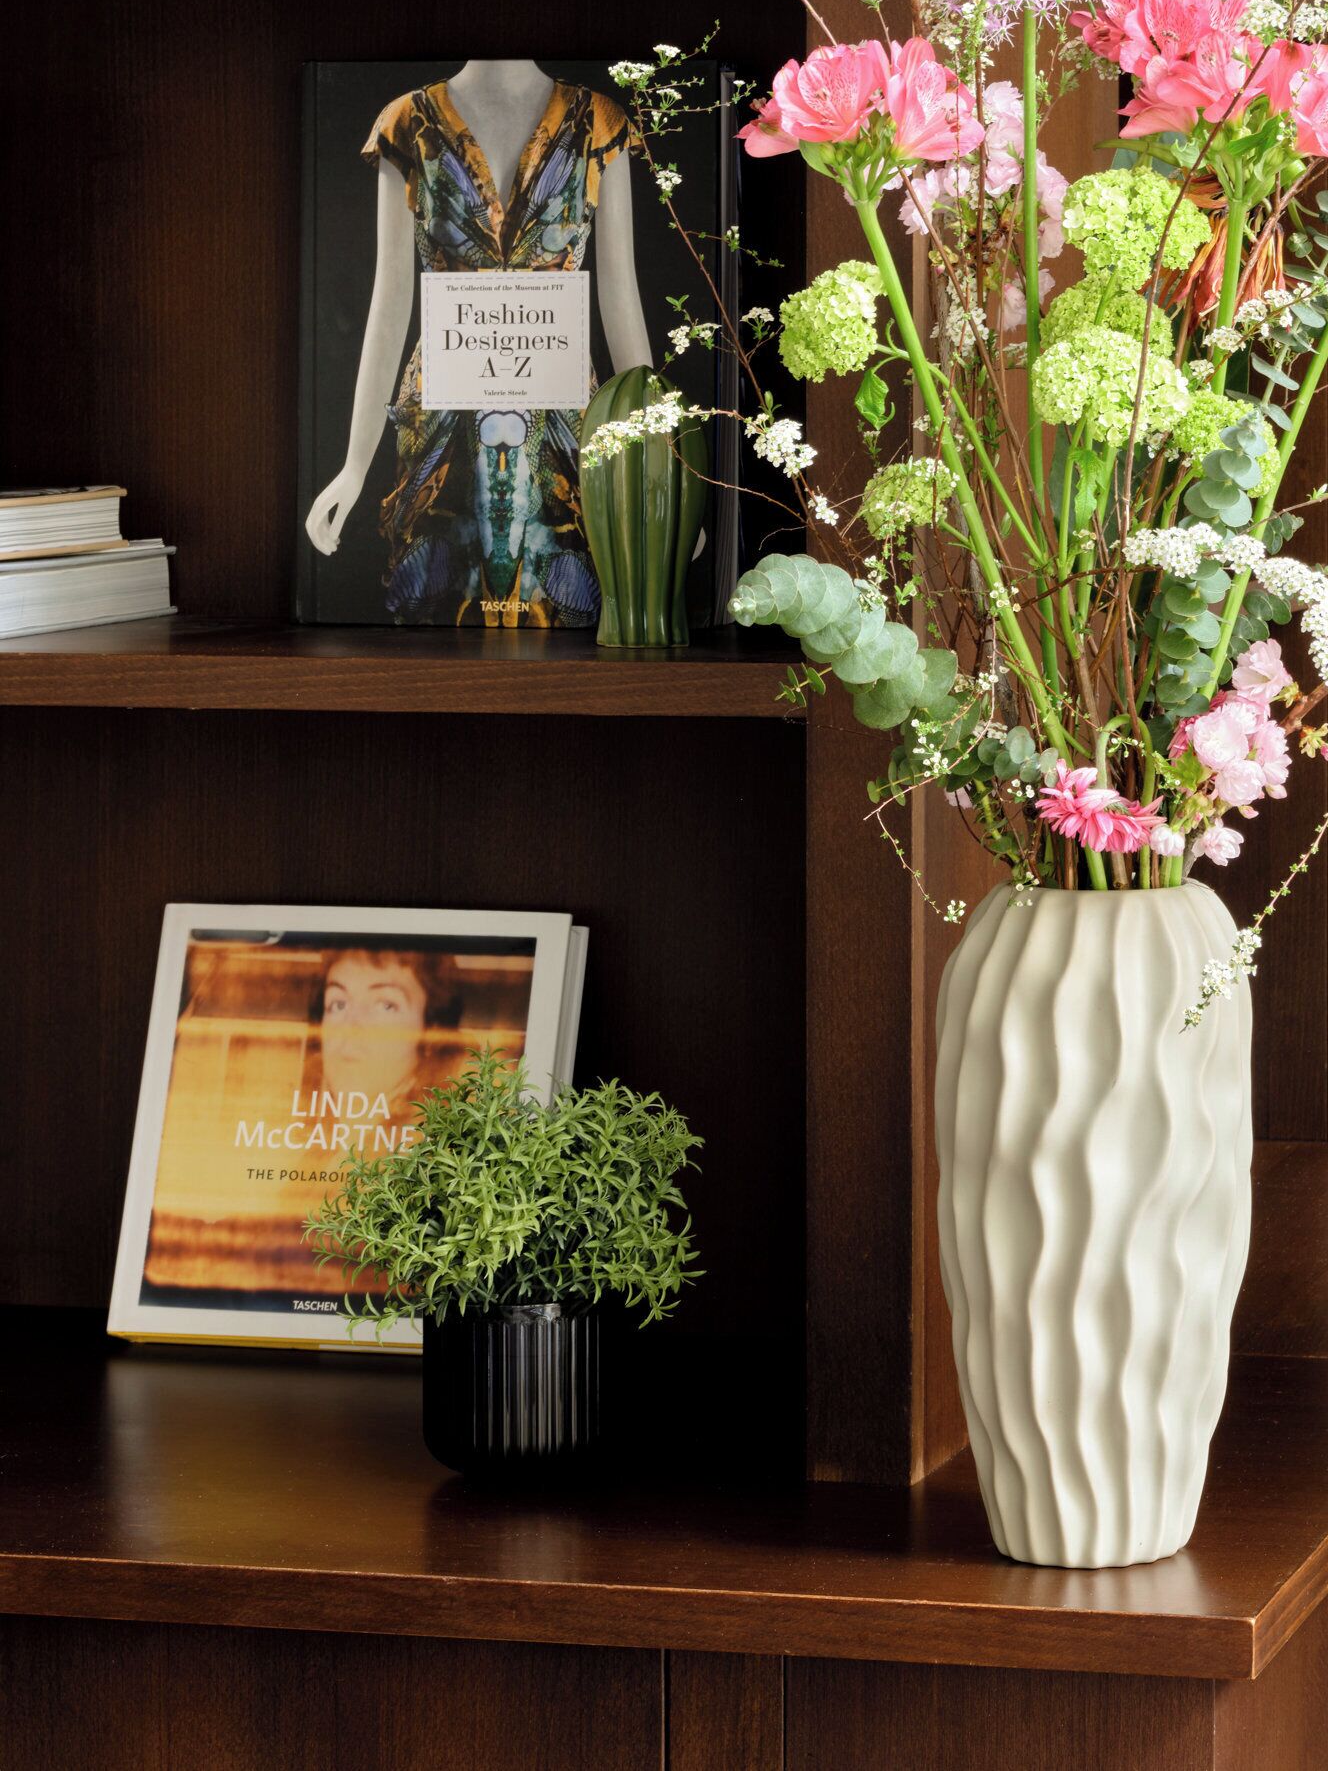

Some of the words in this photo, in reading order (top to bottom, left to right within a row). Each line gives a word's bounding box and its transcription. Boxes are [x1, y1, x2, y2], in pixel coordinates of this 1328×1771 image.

[455, 303, 556, 325] Fashion
[441, 329, 569, 356] Designers
[480, 601, 530, 612] TASCHEN
[291, 1090, 391, 1120] LINDA
[234, 1120, 418, 1154] McCARTNE
[247, 1169, 275, 1180] THE
[292, 1300, 338, 1312] TASCHEN
